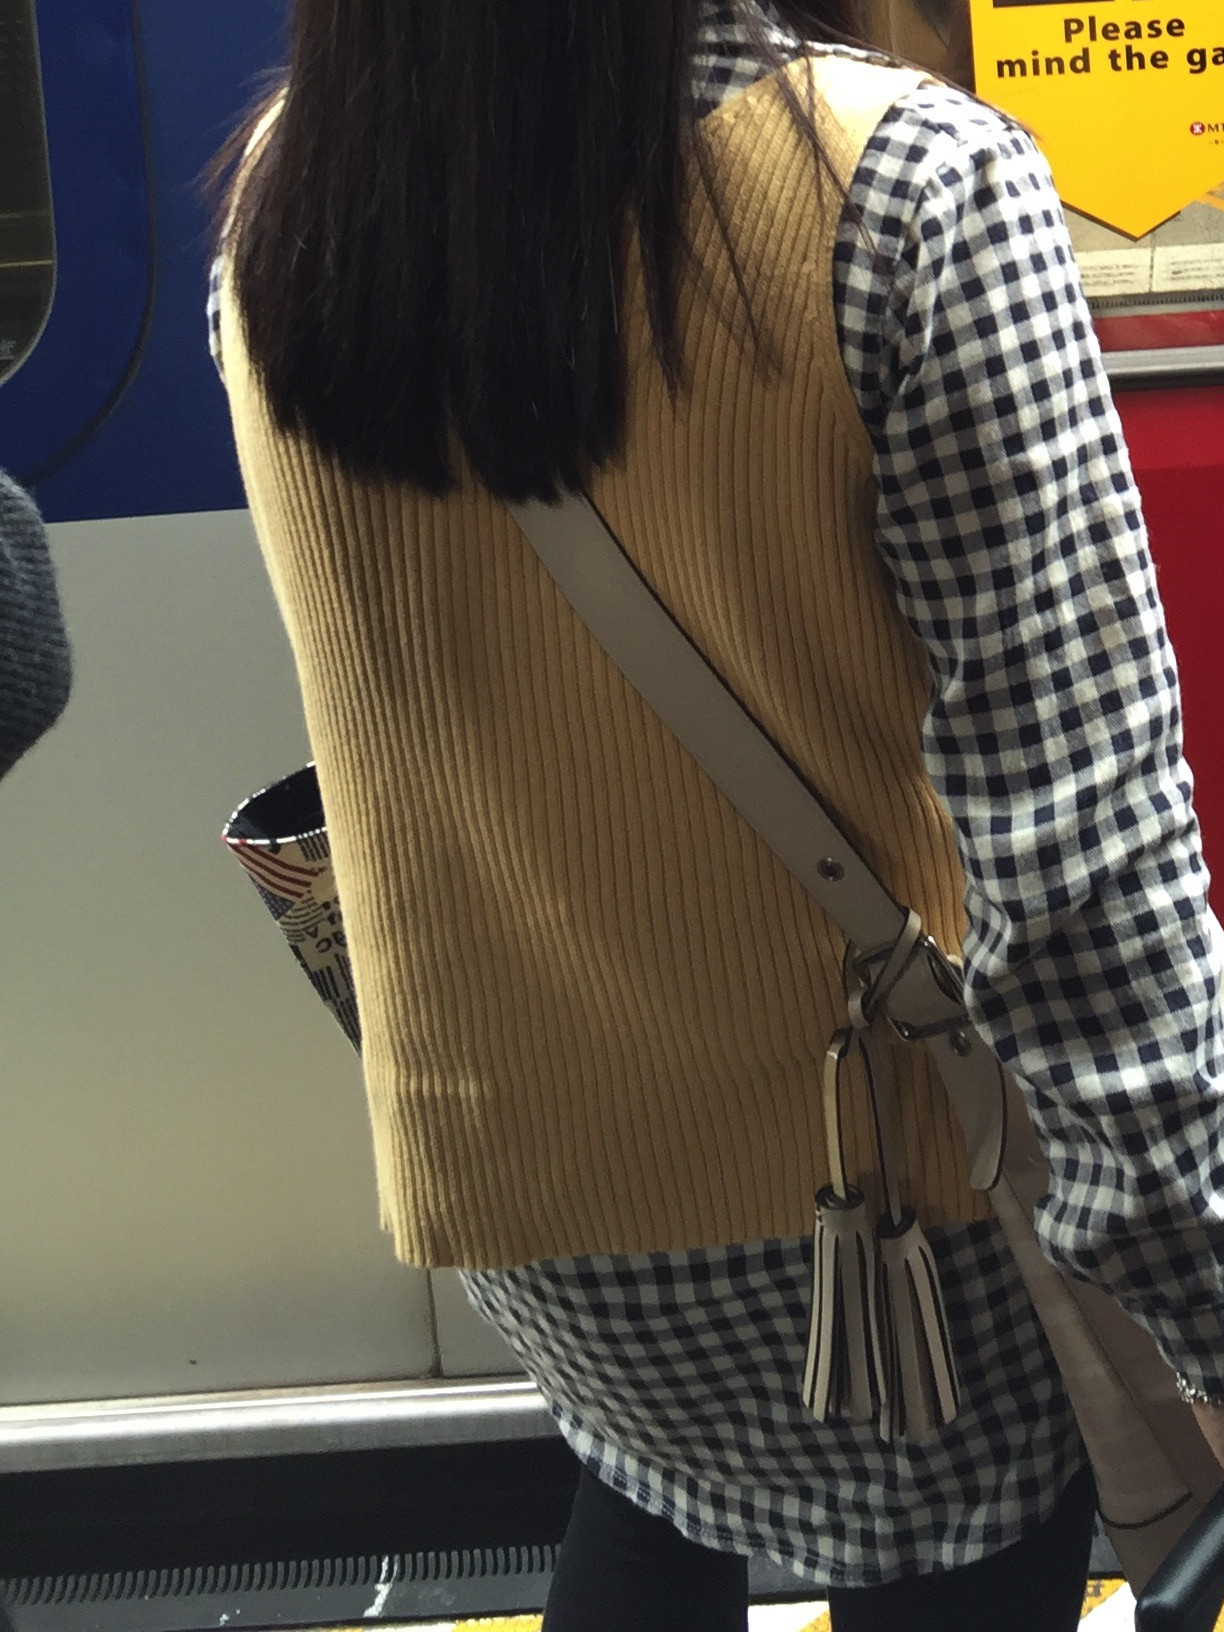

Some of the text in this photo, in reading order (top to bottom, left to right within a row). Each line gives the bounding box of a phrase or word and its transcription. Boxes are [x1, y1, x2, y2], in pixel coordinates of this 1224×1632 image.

[1063, 15, 1185, 43] Please
[996, 47, 1091, 78] mind
[1107, 44, 1169, 72] the
